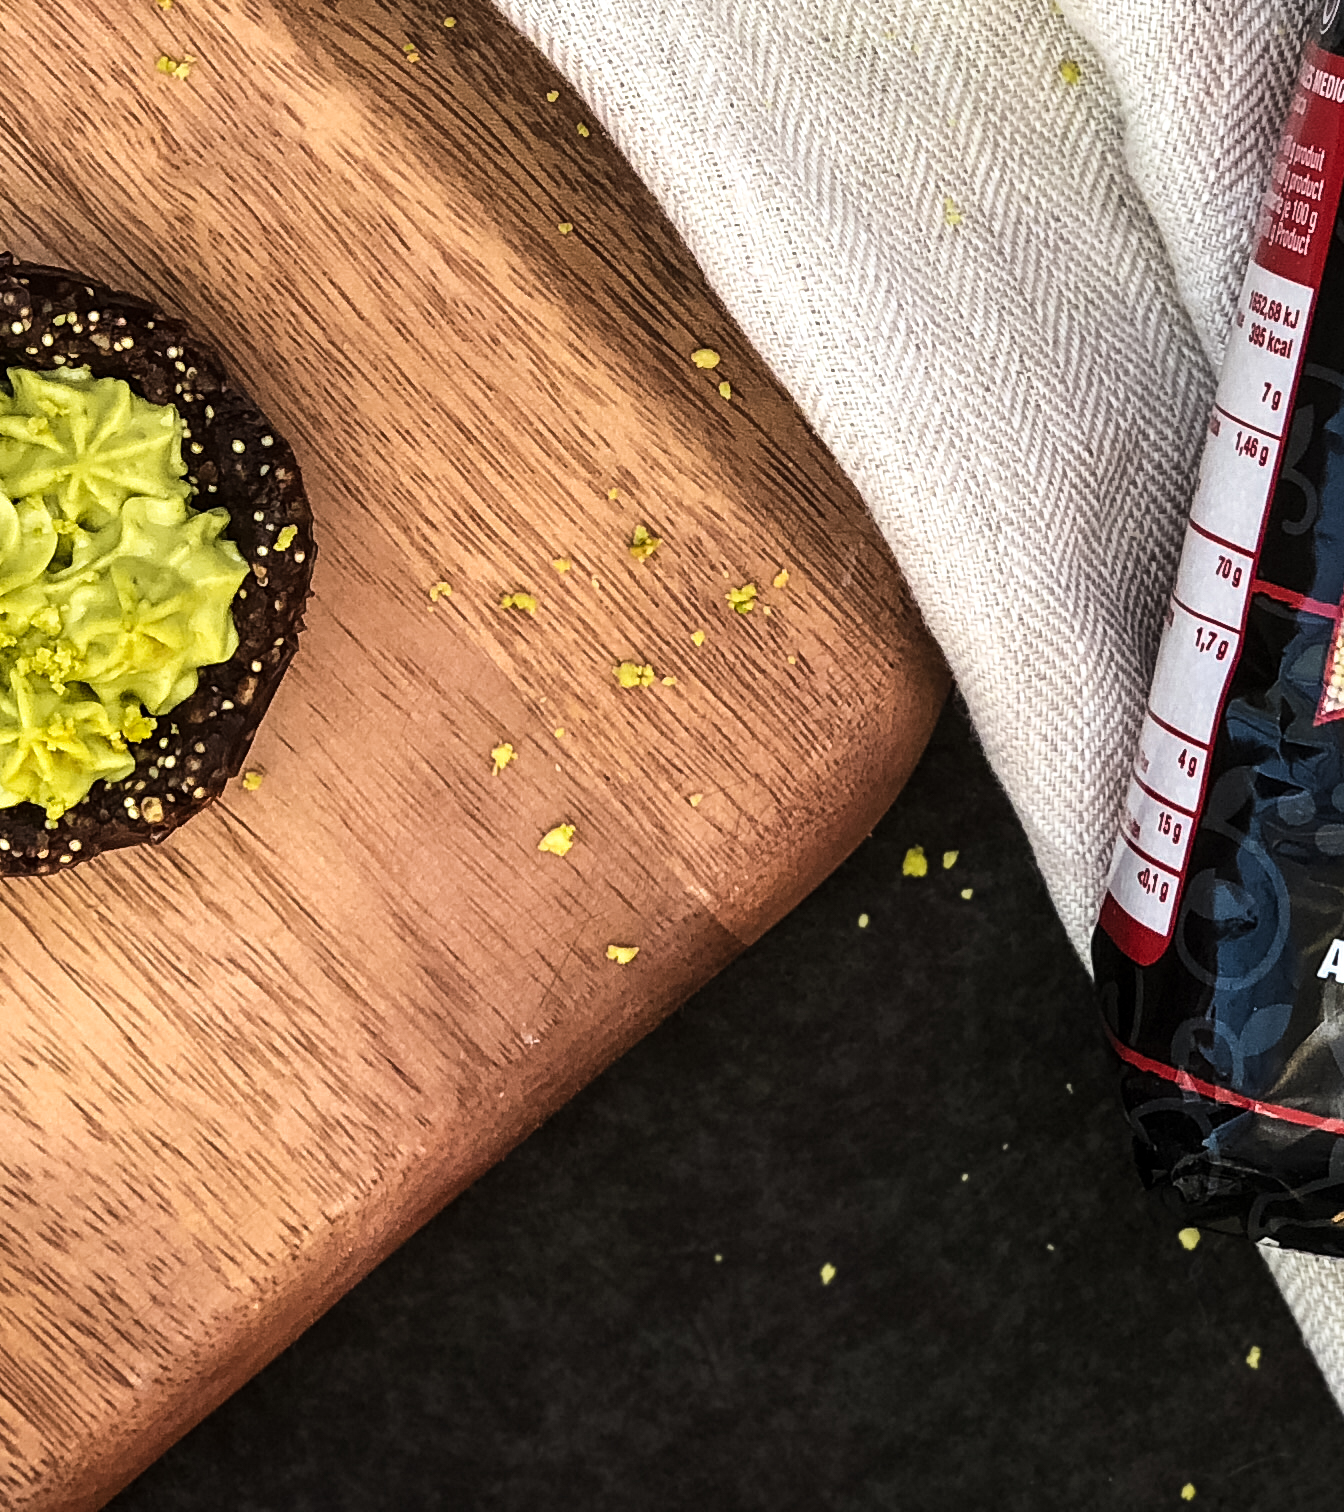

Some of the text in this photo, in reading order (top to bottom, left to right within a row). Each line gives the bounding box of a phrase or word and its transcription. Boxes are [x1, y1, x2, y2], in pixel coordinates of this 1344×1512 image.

[1292, 199, 1310, 226] 100
[1307, 210, 1319, 235] g
[1282, 305, 1301, 330] kJ
[1266, 329, 1294, 360] kcal
[1261, 381, 1282, 411] 7 g
[1234, 429, 1270, 467] 1,46 g
[1215, 554, 1243, 588] 70 g
[1195, 626, 1230, 661] 1,7 g
[1177, 748, 1198, 778] 4 g
[1157, 811, 1173, 836] 15
[1171, 823, 1183, 845] g
[1158, 881, 1170, 903] g
